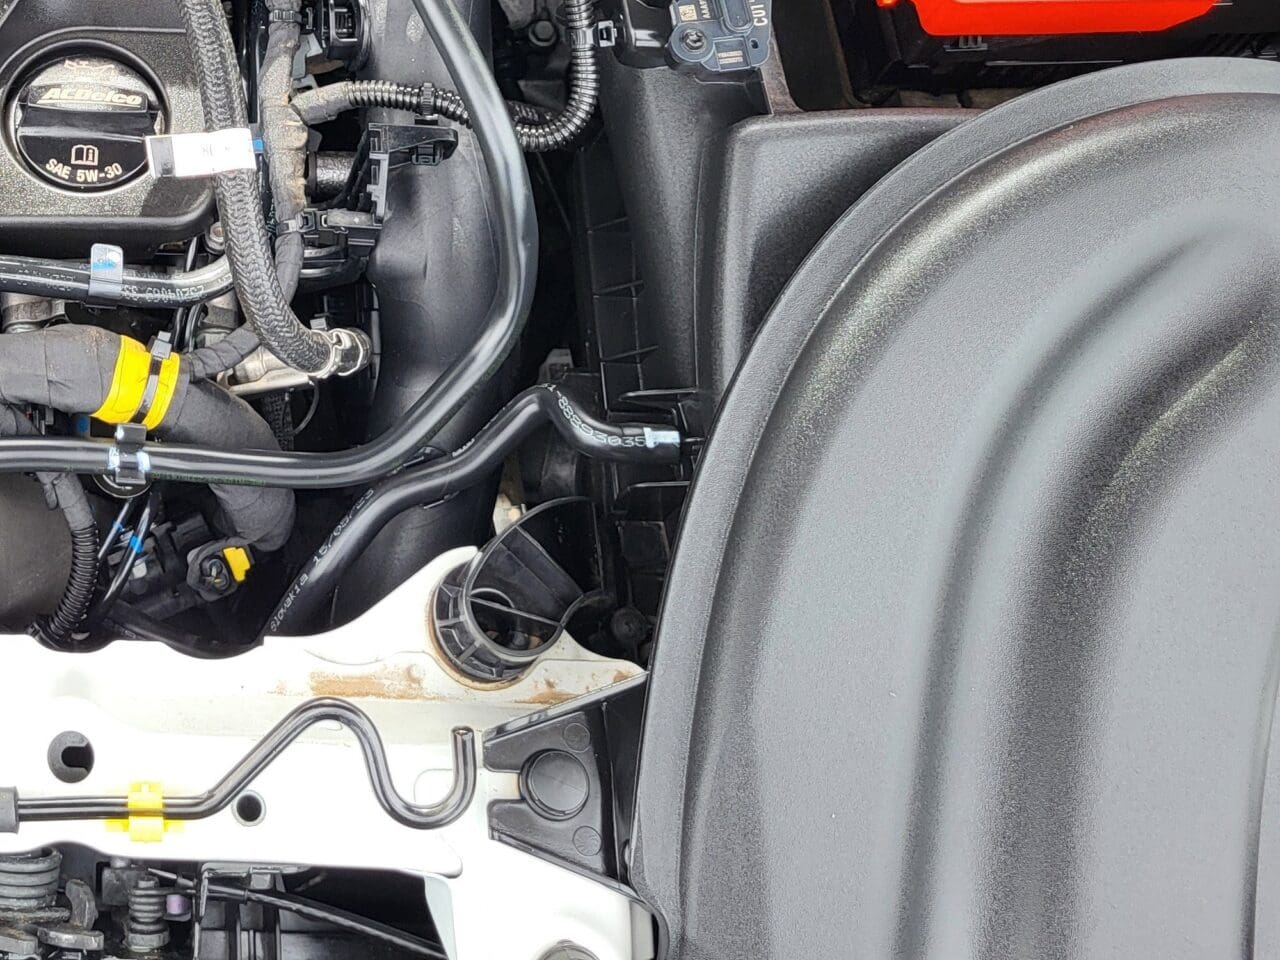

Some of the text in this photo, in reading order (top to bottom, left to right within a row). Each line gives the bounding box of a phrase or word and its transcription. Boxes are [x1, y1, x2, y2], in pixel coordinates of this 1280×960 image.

[41, 88, 143, 104] ACDelco
[45, 158, 122, 183] SAE 5W-30
